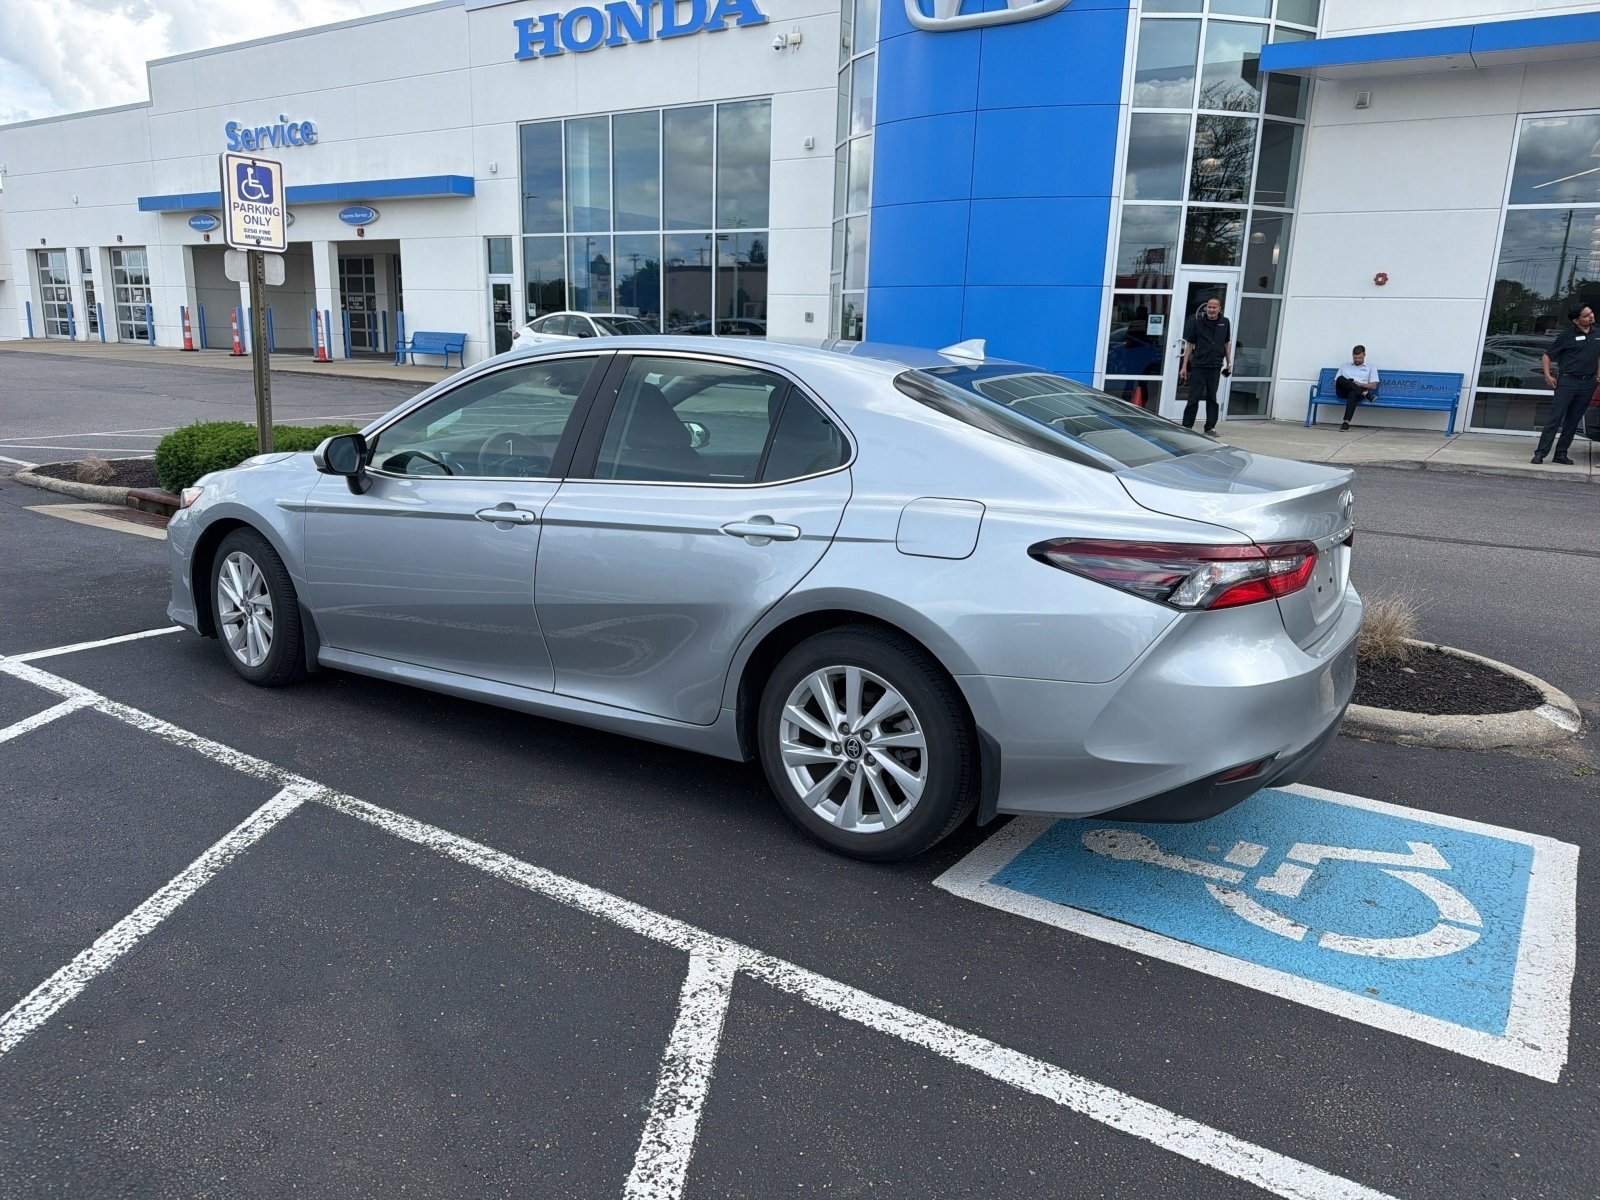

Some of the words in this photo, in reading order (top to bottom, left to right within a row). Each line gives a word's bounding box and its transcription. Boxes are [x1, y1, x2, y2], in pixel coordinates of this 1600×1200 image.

[513, 0, 769, 61] HONDA
[225, 114, 318, 152] Service
[233, 202, 280, 217] PARKING
[243, 214, 271, 226] ONLY
